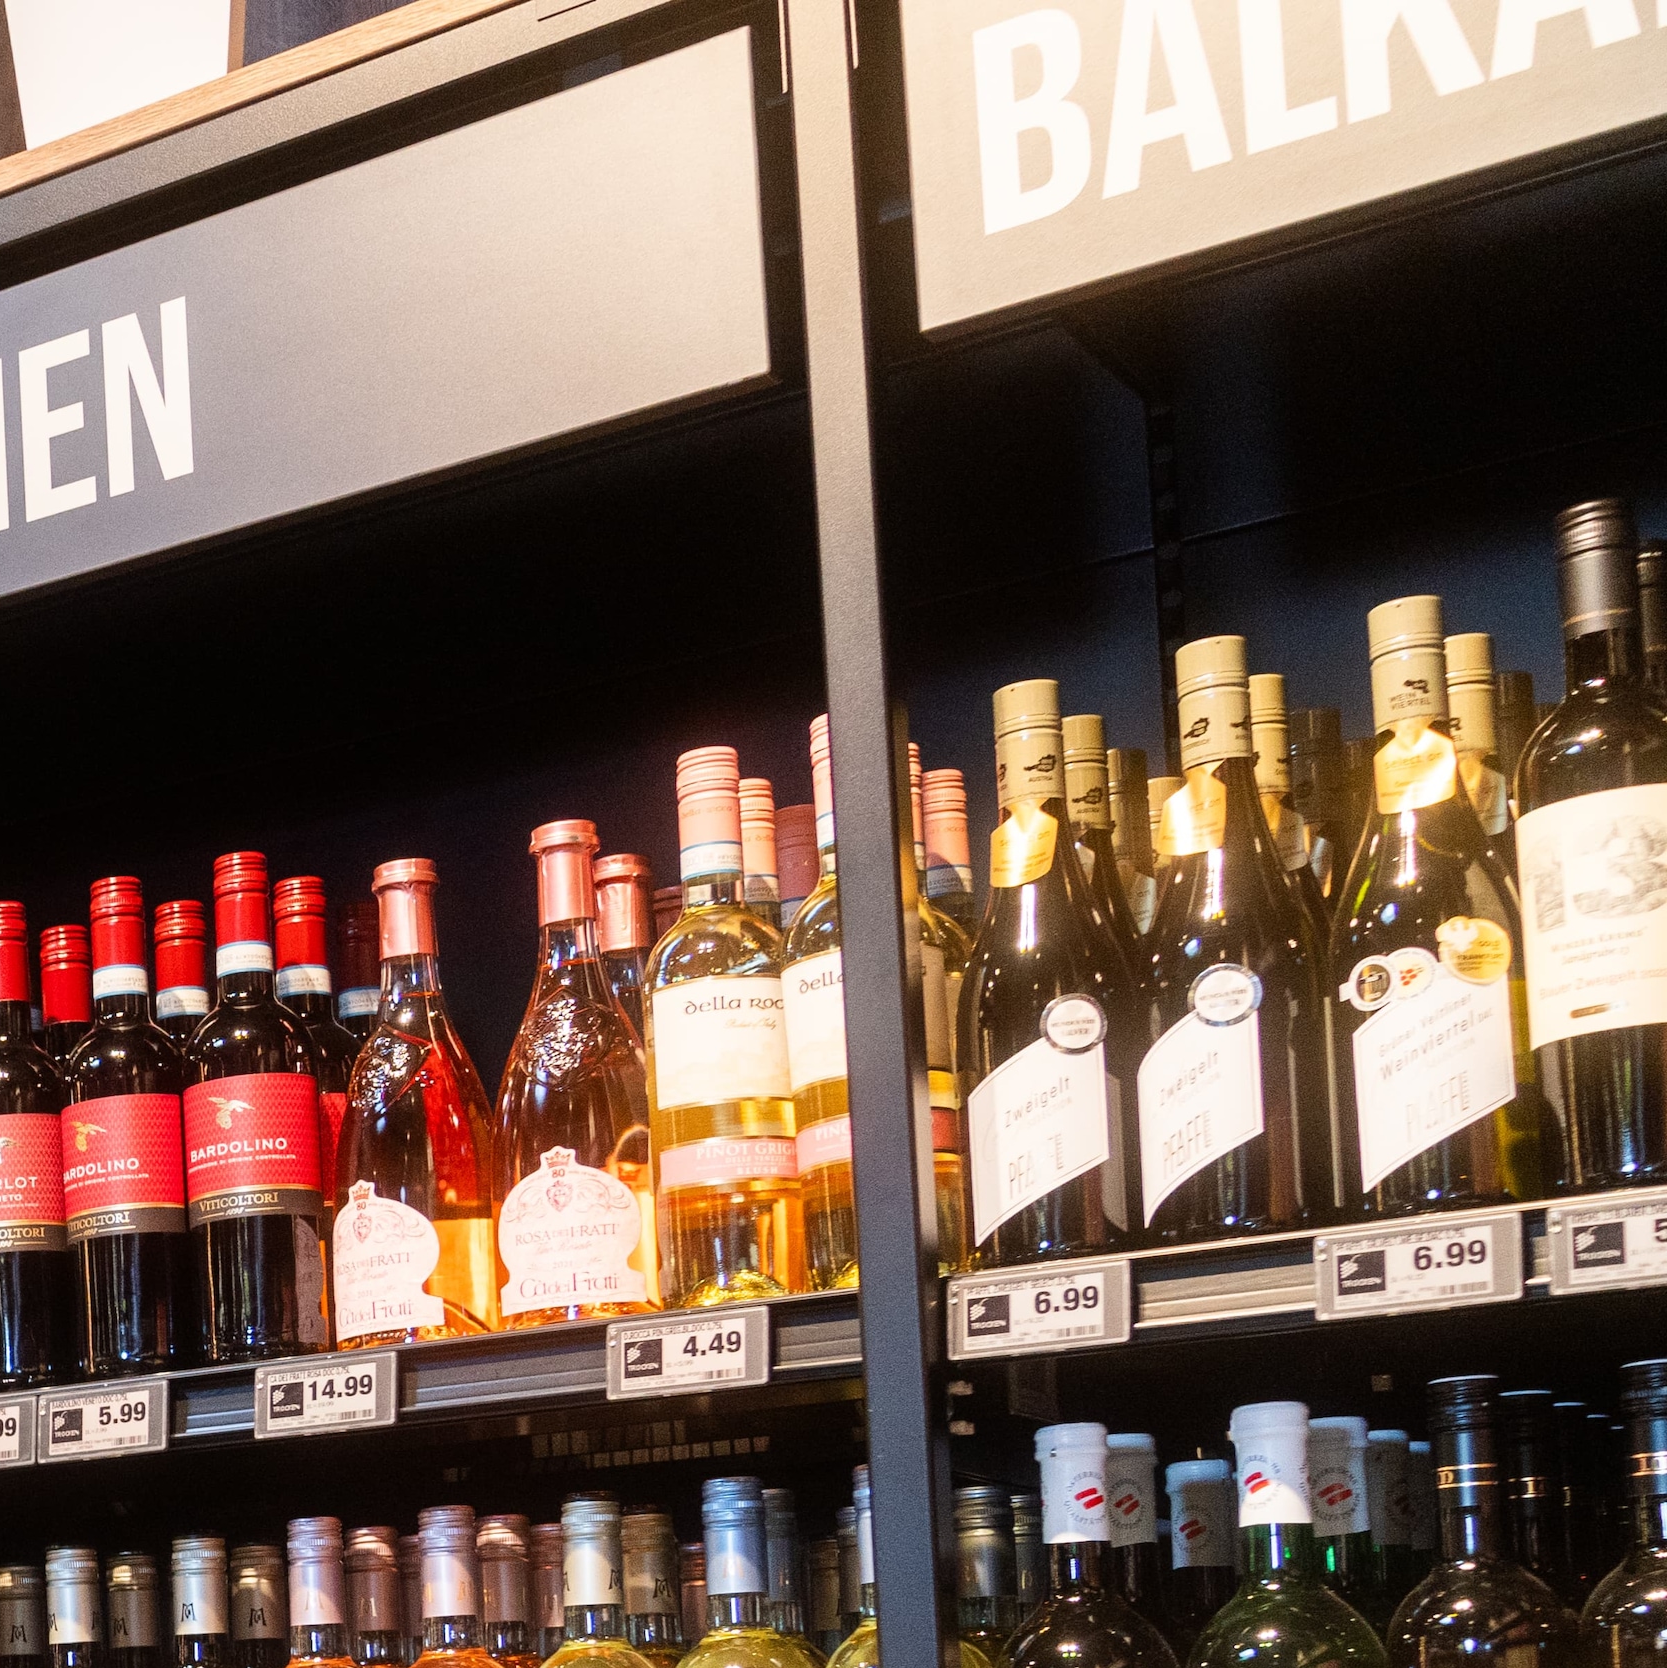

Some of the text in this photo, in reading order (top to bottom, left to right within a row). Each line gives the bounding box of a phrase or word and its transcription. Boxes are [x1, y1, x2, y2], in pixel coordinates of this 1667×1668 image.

[1004, 1075, 1071, 1128] Zweigelt
[190, 1137, 288, 1163] BARDOLINO
[696, 1143, 749, 1160] PINOT
[737, 1166, 778, 1175] BLUSH
[199, 1191, 279, 1213] VITICOLTORI
[515, 1230, 552, 1246] ROSA
[1413, 1239, 1487, 1271] 6.99
[1034, 1285, 1099, 1315] 6.99
[683, 1331, 742, 1358] 4.49
[627, 1362, 659, 1371] TROCKEN
[307, 1374, 373, 1402] 14.99
[99, 1402, 146, 1425] 5.99
[272, 1404, 301, 1413] TROCKEN
